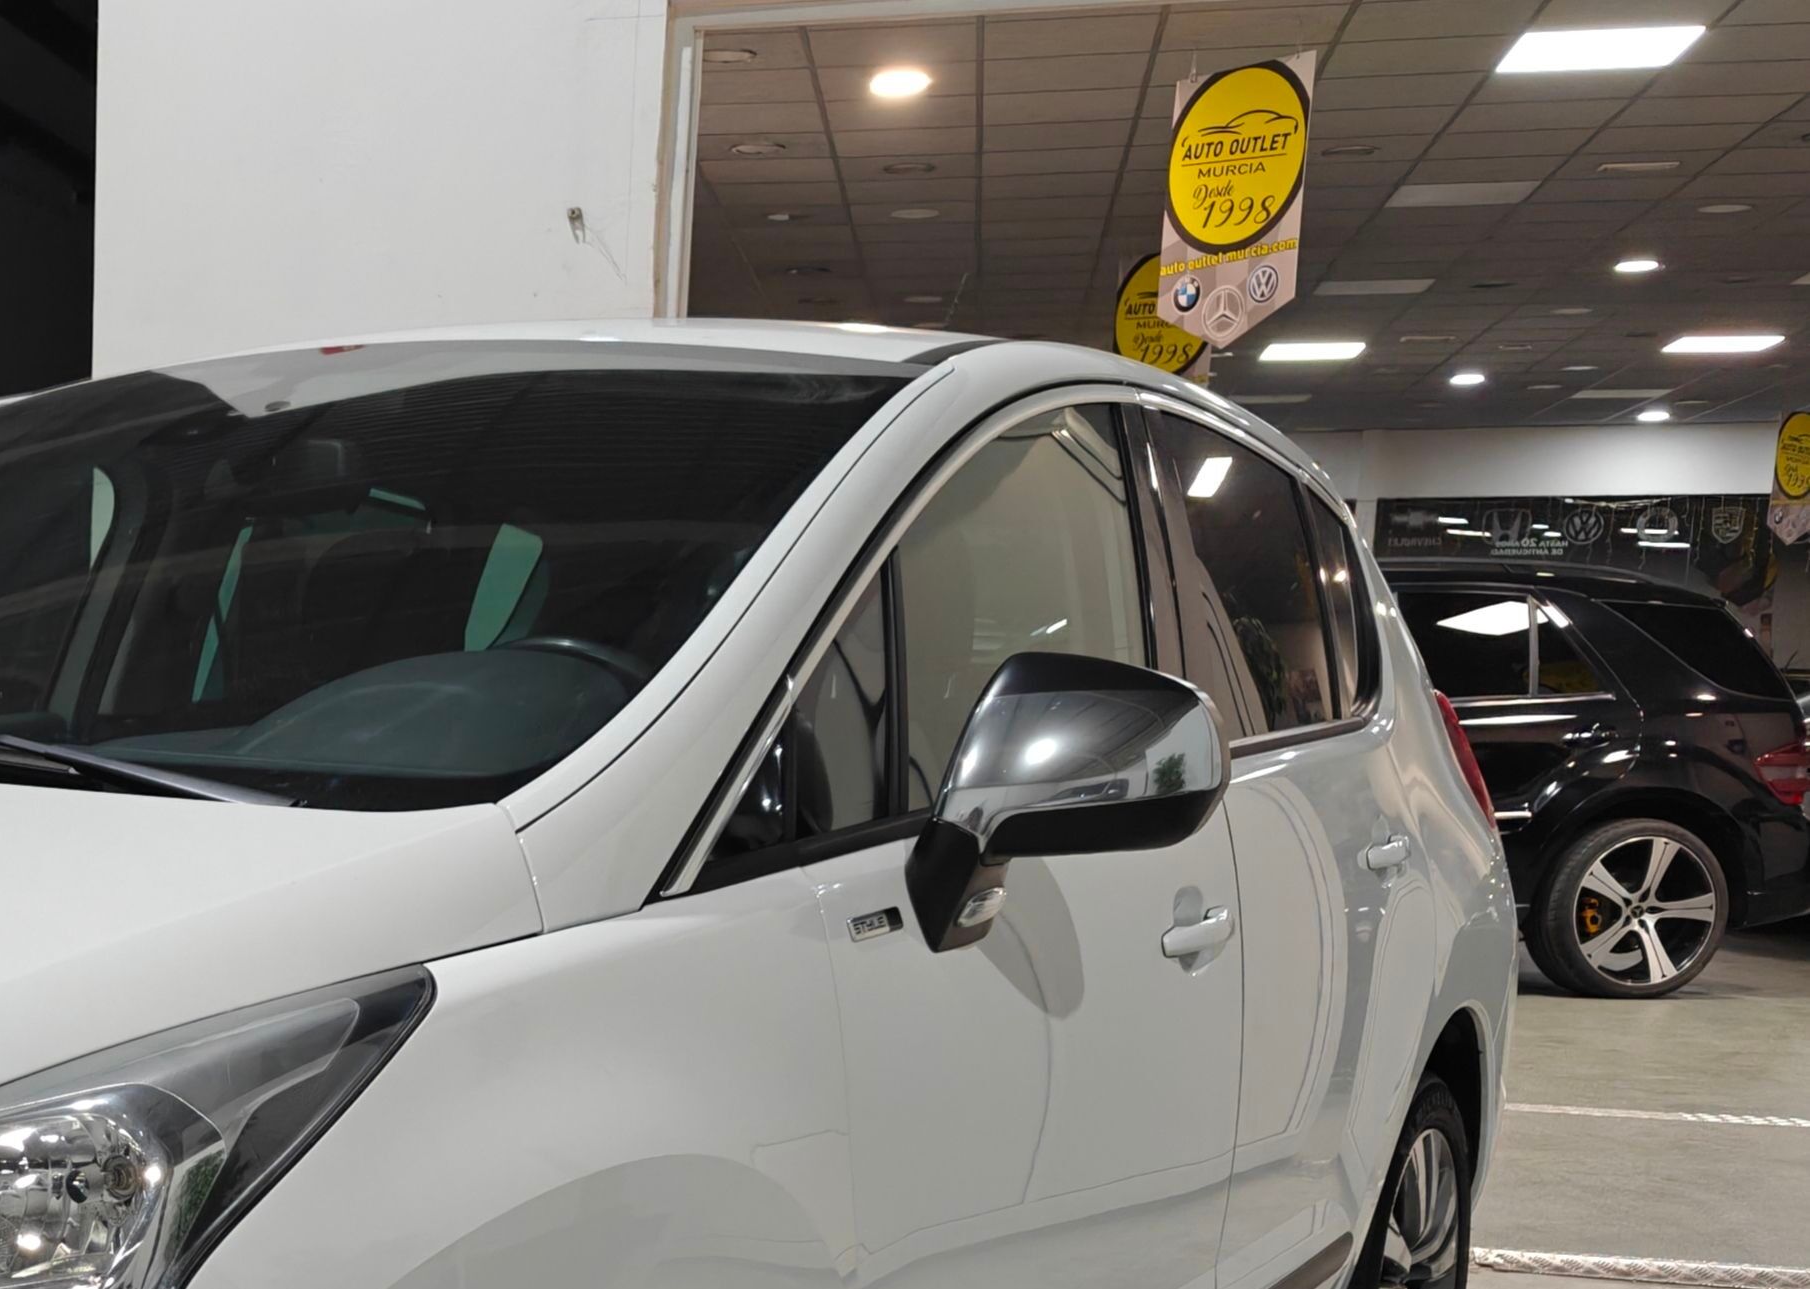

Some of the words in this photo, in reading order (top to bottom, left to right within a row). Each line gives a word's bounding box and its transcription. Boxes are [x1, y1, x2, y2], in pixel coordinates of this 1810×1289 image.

[1182, 140, 1224, 161] AUTO
[1229, 133, 1292, 155] OUTLET
[1197, 161, 1266, 178] MURCIA
[1193, 179, 1234, 210] Desde
[1202, 194, 1276, 229] 1998
[1125, 302, 1156, 315] AUTO
[1141, 342, 1194, 365] 1998
[853, 916, 887, 935] STYLE
